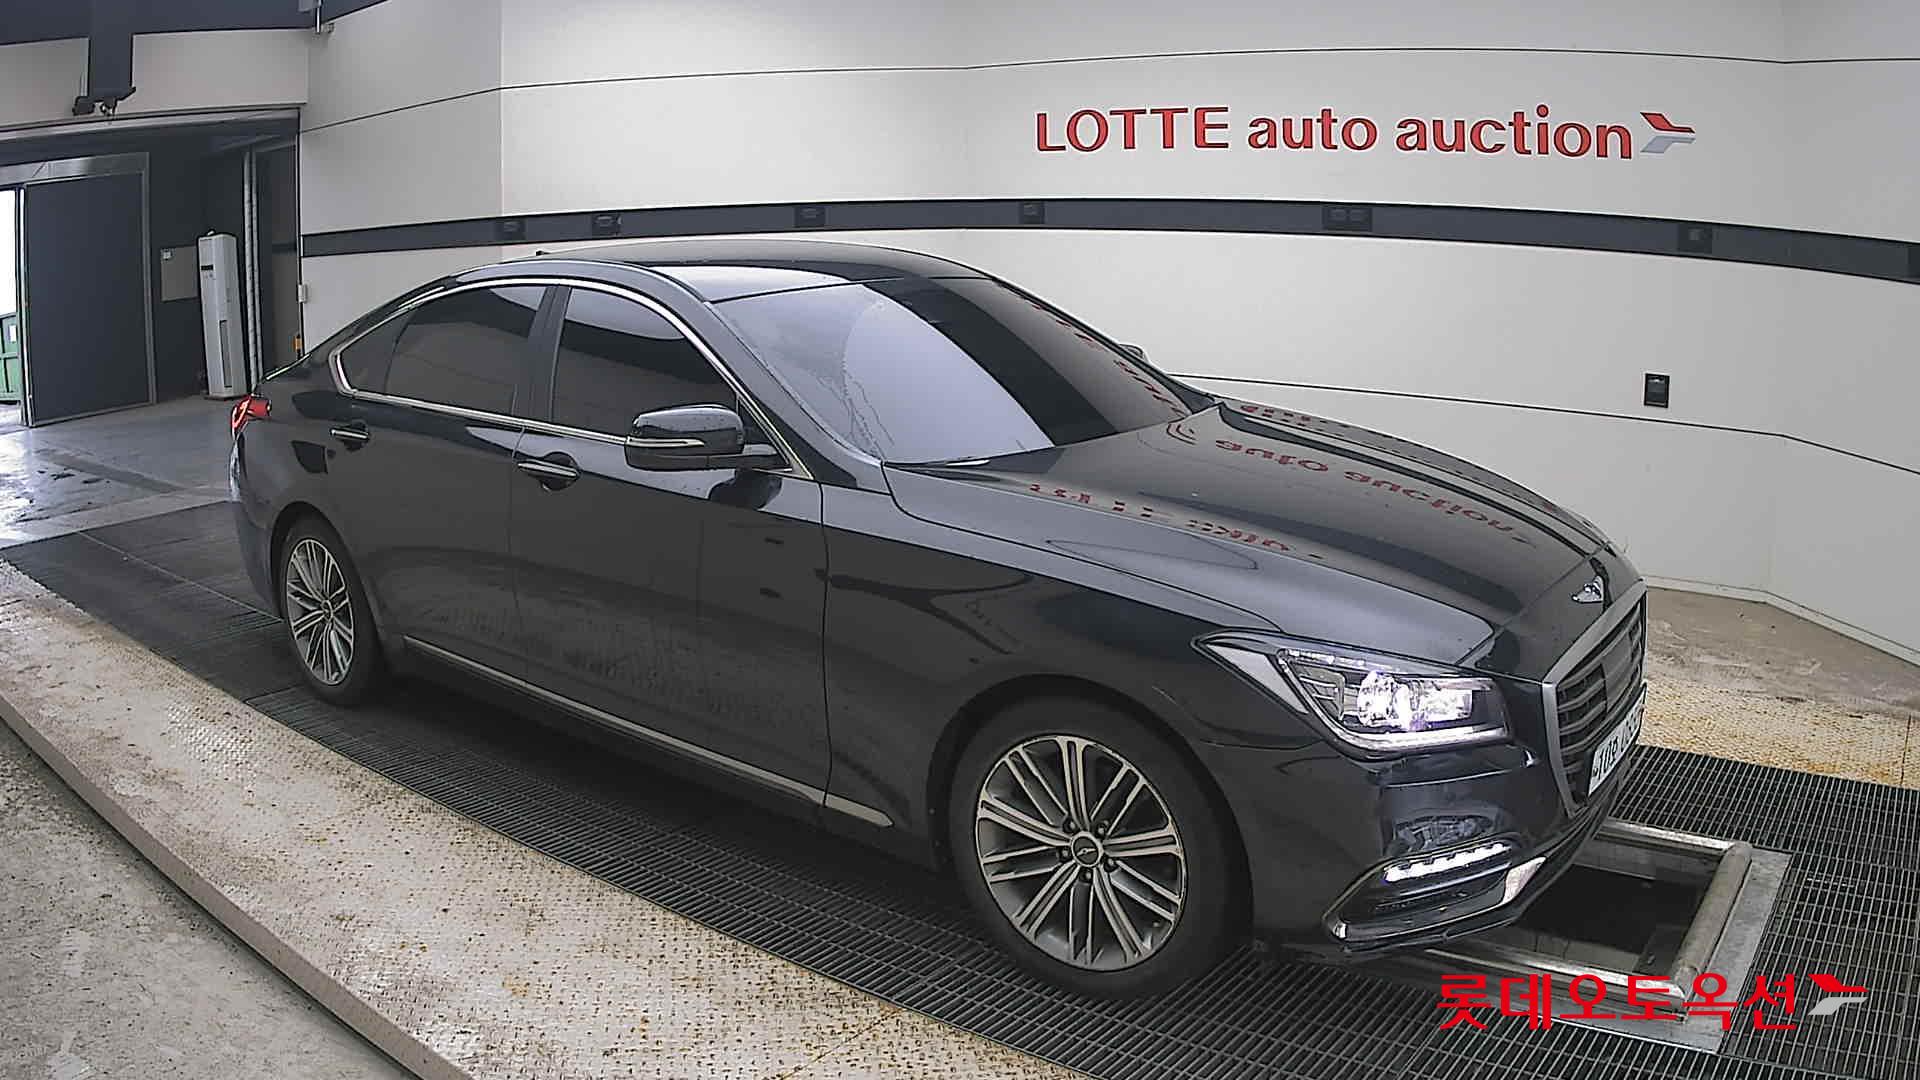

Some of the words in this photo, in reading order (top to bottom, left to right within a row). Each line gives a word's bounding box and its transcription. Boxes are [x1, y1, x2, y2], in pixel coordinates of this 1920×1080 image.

[1036, 106, 1230, 152] LOTTE
[1247, 107, 1378, 151] auto
[1396, 104, 1633, 160] auction
